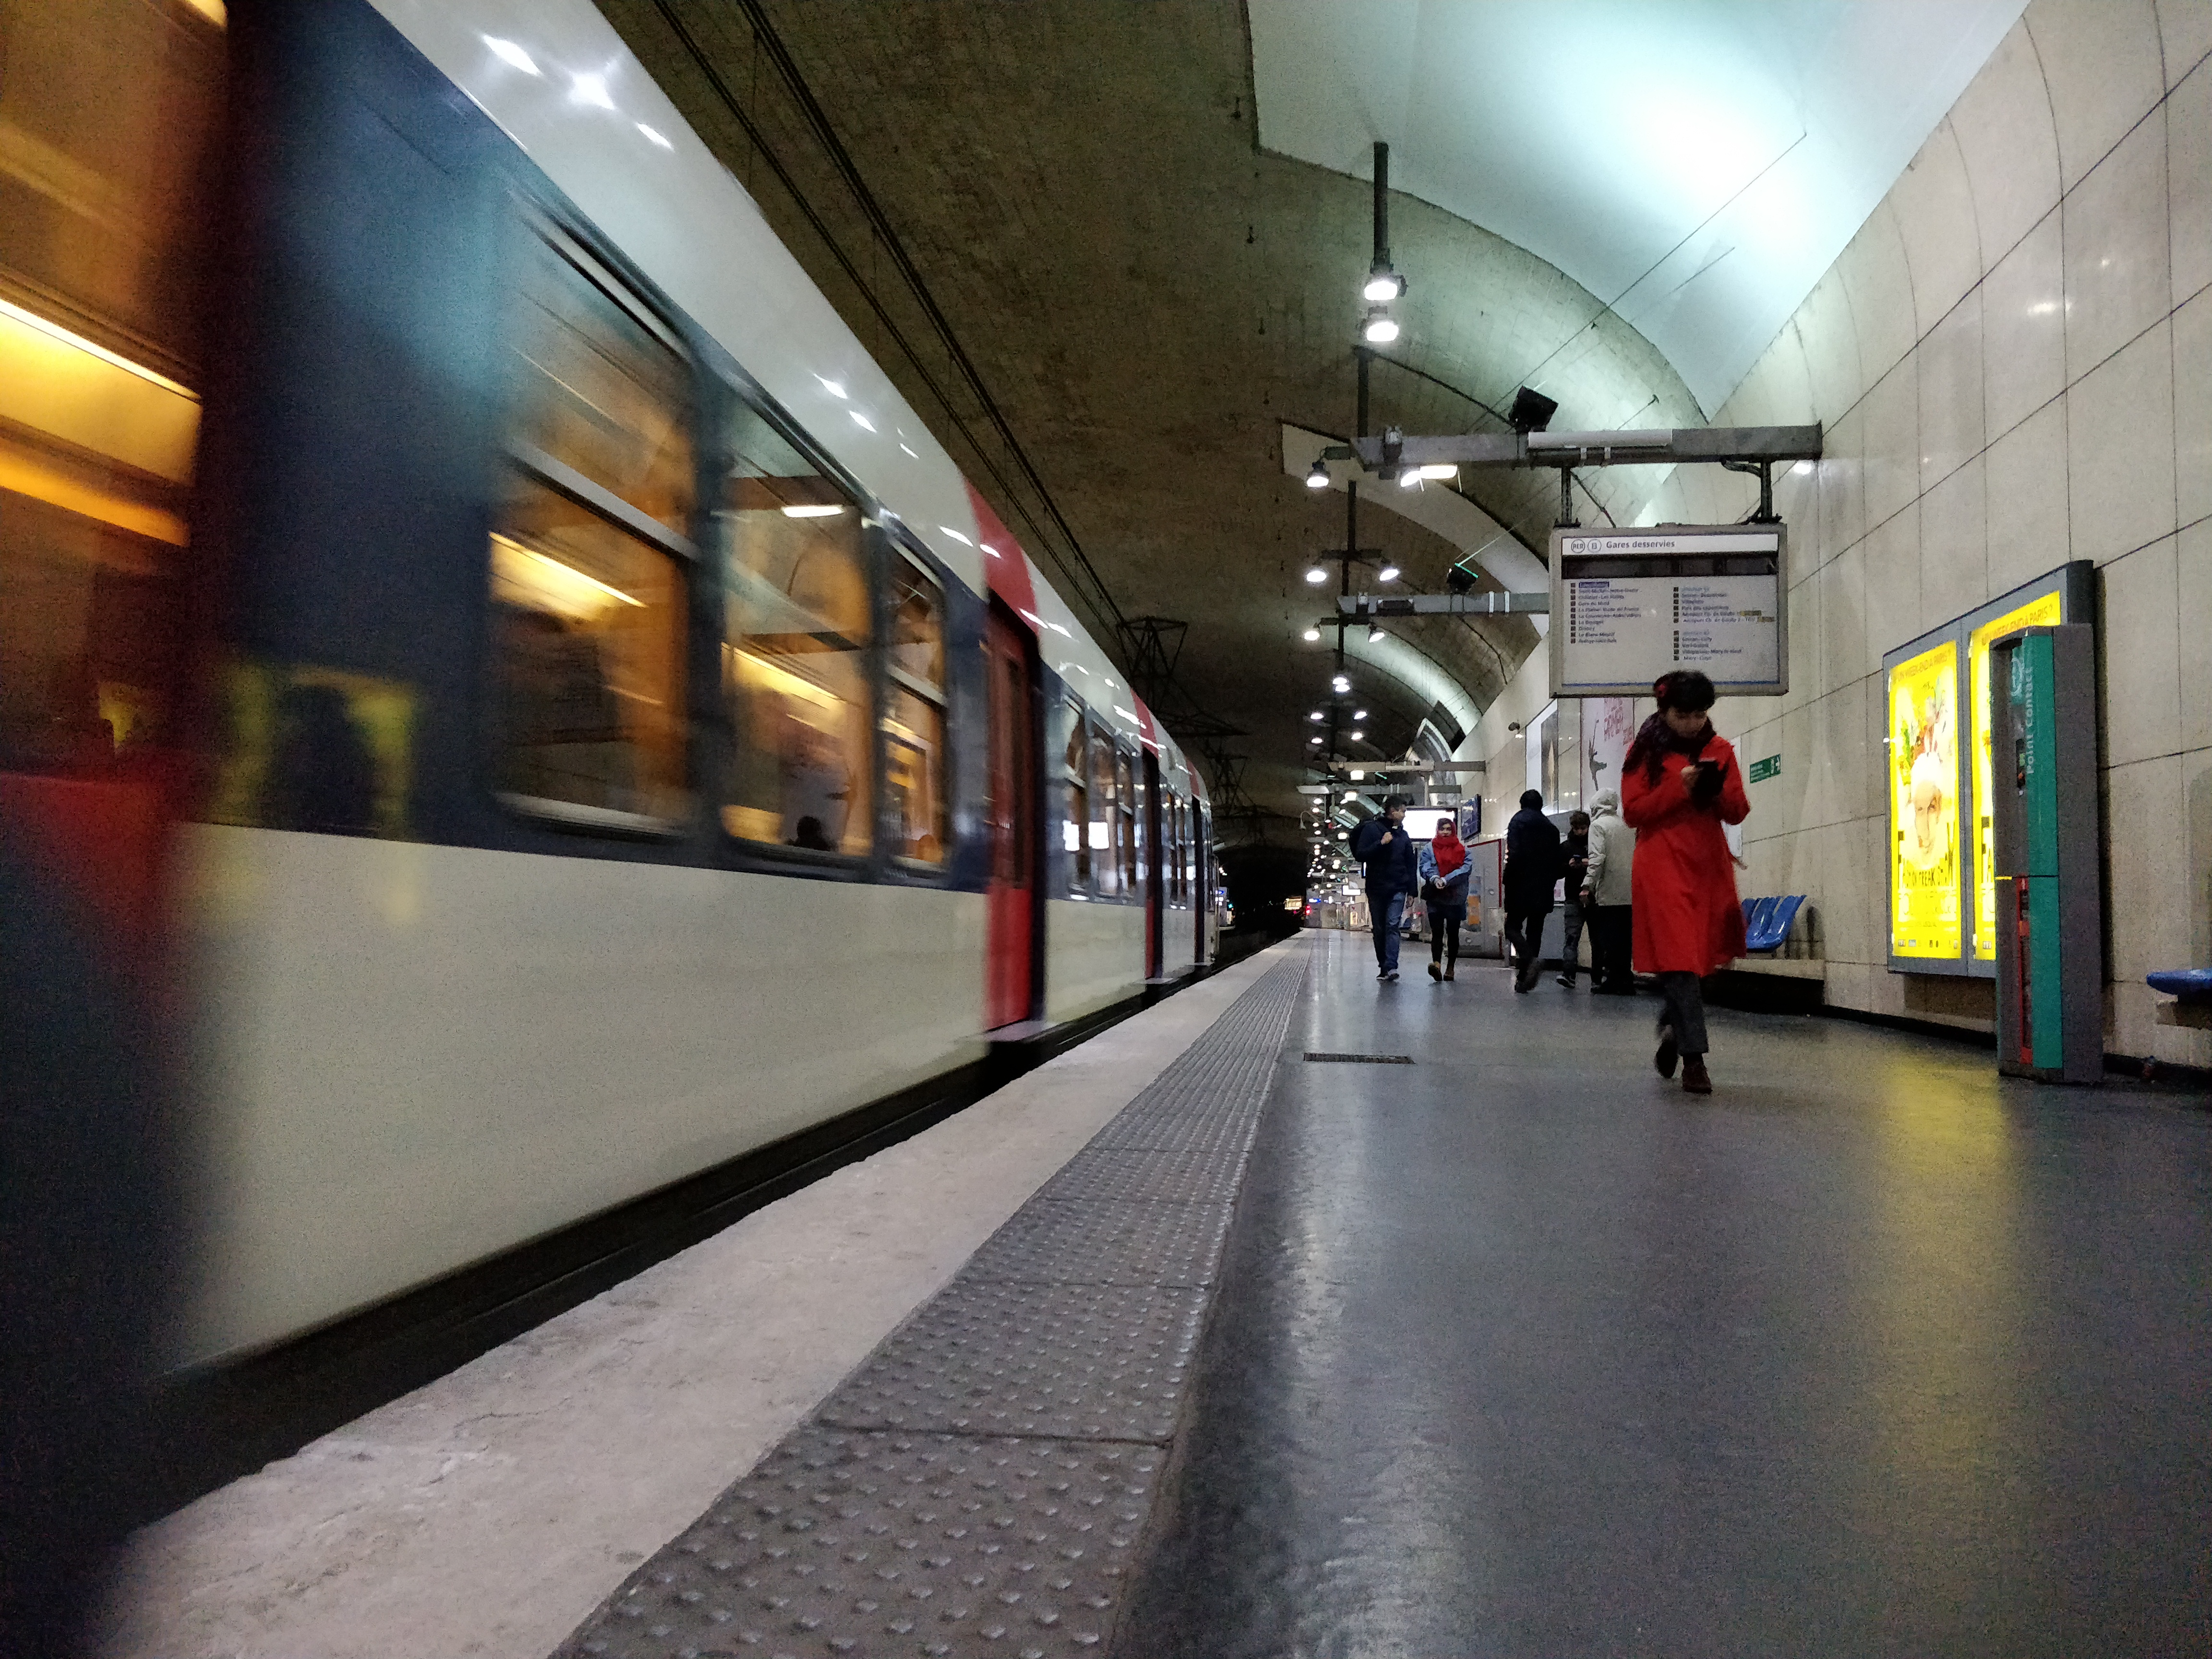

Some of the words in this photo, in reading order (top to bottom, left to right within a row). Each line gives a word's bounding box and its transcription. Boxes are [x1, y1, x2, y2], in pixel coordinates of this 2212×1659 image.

[1632, 540, 1675, 548] desservies
[2029, 605, 2048, 625] PARIS
[2026, 733, 2034, 774] Point
[1919, 868, 1936, 887] FREAK
